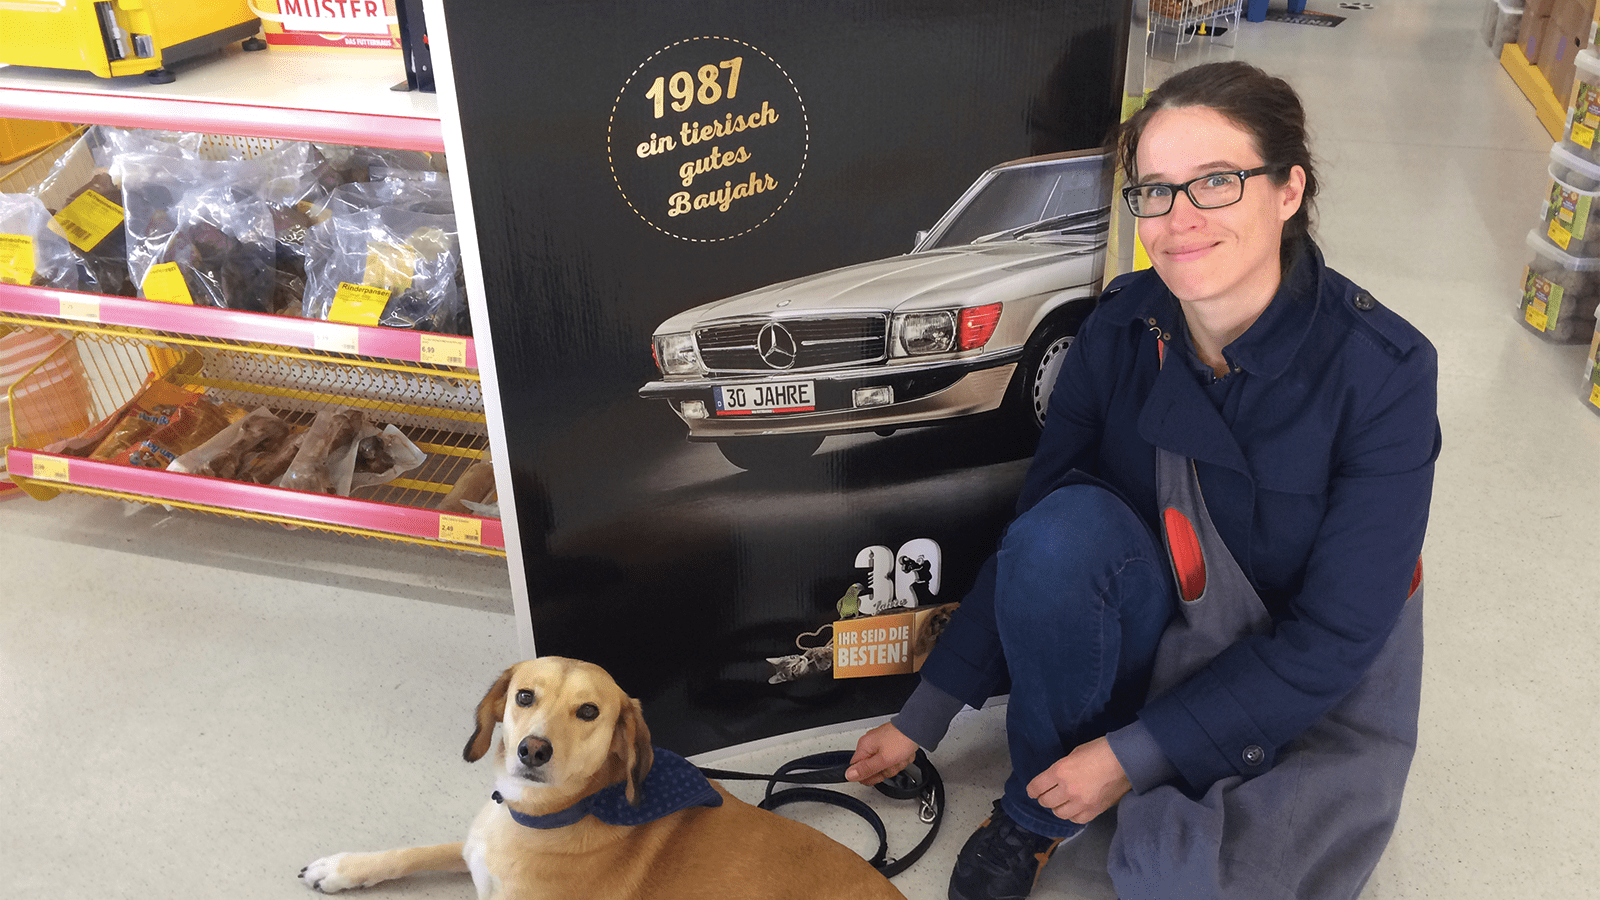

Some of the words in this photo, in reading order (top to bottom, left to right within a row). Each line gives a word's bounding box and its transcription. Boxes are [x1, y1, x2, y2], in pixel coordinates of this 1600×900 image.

[284, 0, 378, 18] MUSTER
[645, 56, 743, 119] 1987
[636, 132, 677, 158] ein
[680, 101, 779, 146] tierisch
[679, 146, 752, 187] gutes
[667, 172, 778, 217] Baujahr
[341, 283, 390, 297] Rinderpansen
[726, 388, 747, 408] 30
[753, 384, 811, 407] JAHRE
[838, 630, 858, 646] IHR
[861, 628, 887, 642] SEID
[889, 625, 909, 640] DIE
[838, 641, 908, 667] BESTEN!
